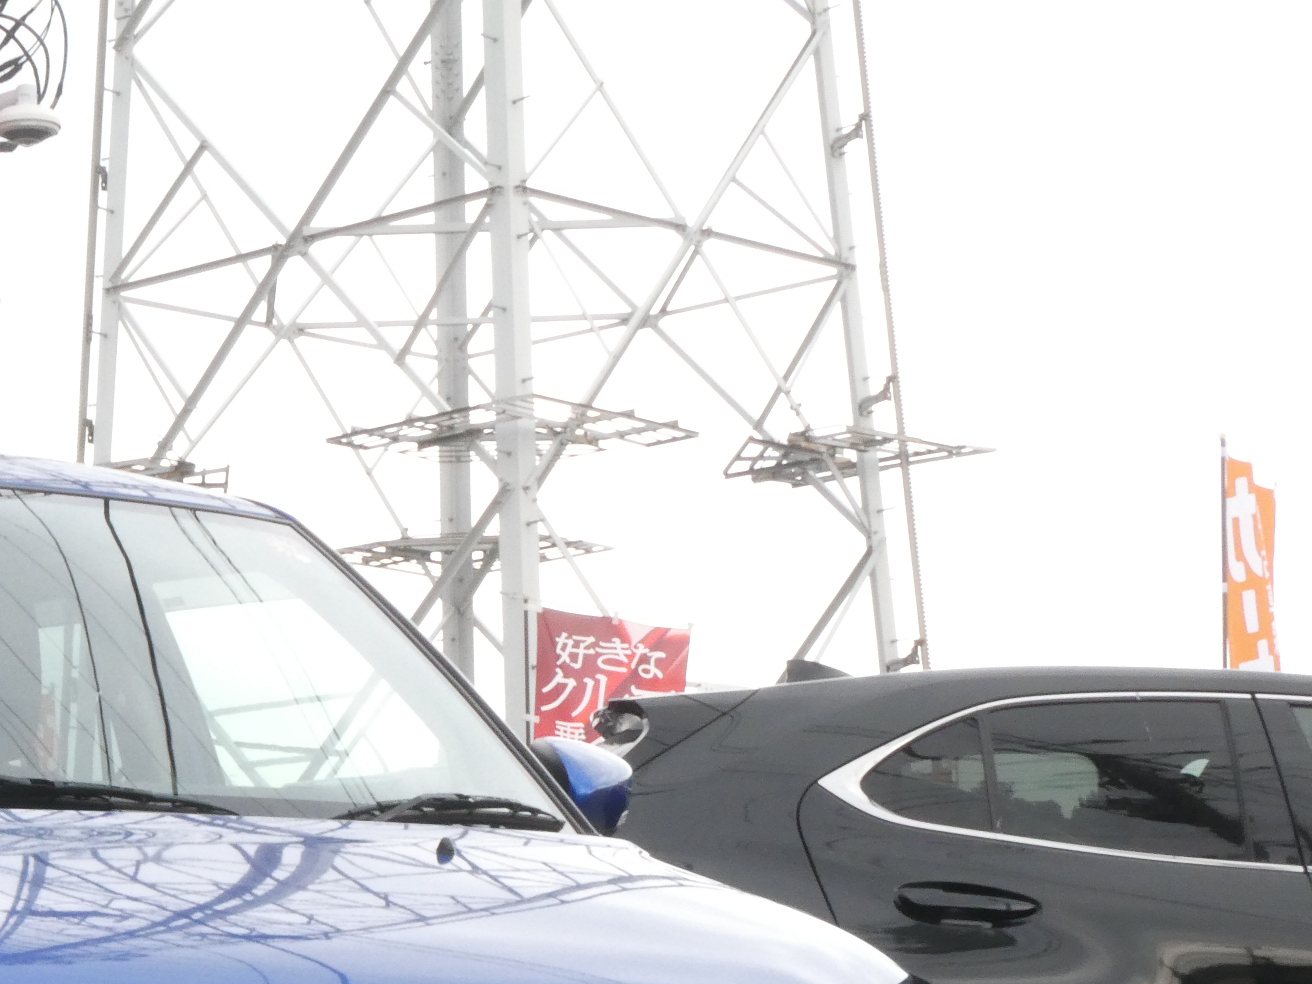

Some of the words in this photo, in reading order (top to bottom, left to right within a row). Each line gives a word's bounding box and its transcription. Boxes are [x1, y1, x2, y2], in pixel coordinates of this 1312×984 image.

[555, 632, 666, 679] 好きな
[540, 667, 678, 717] クル
